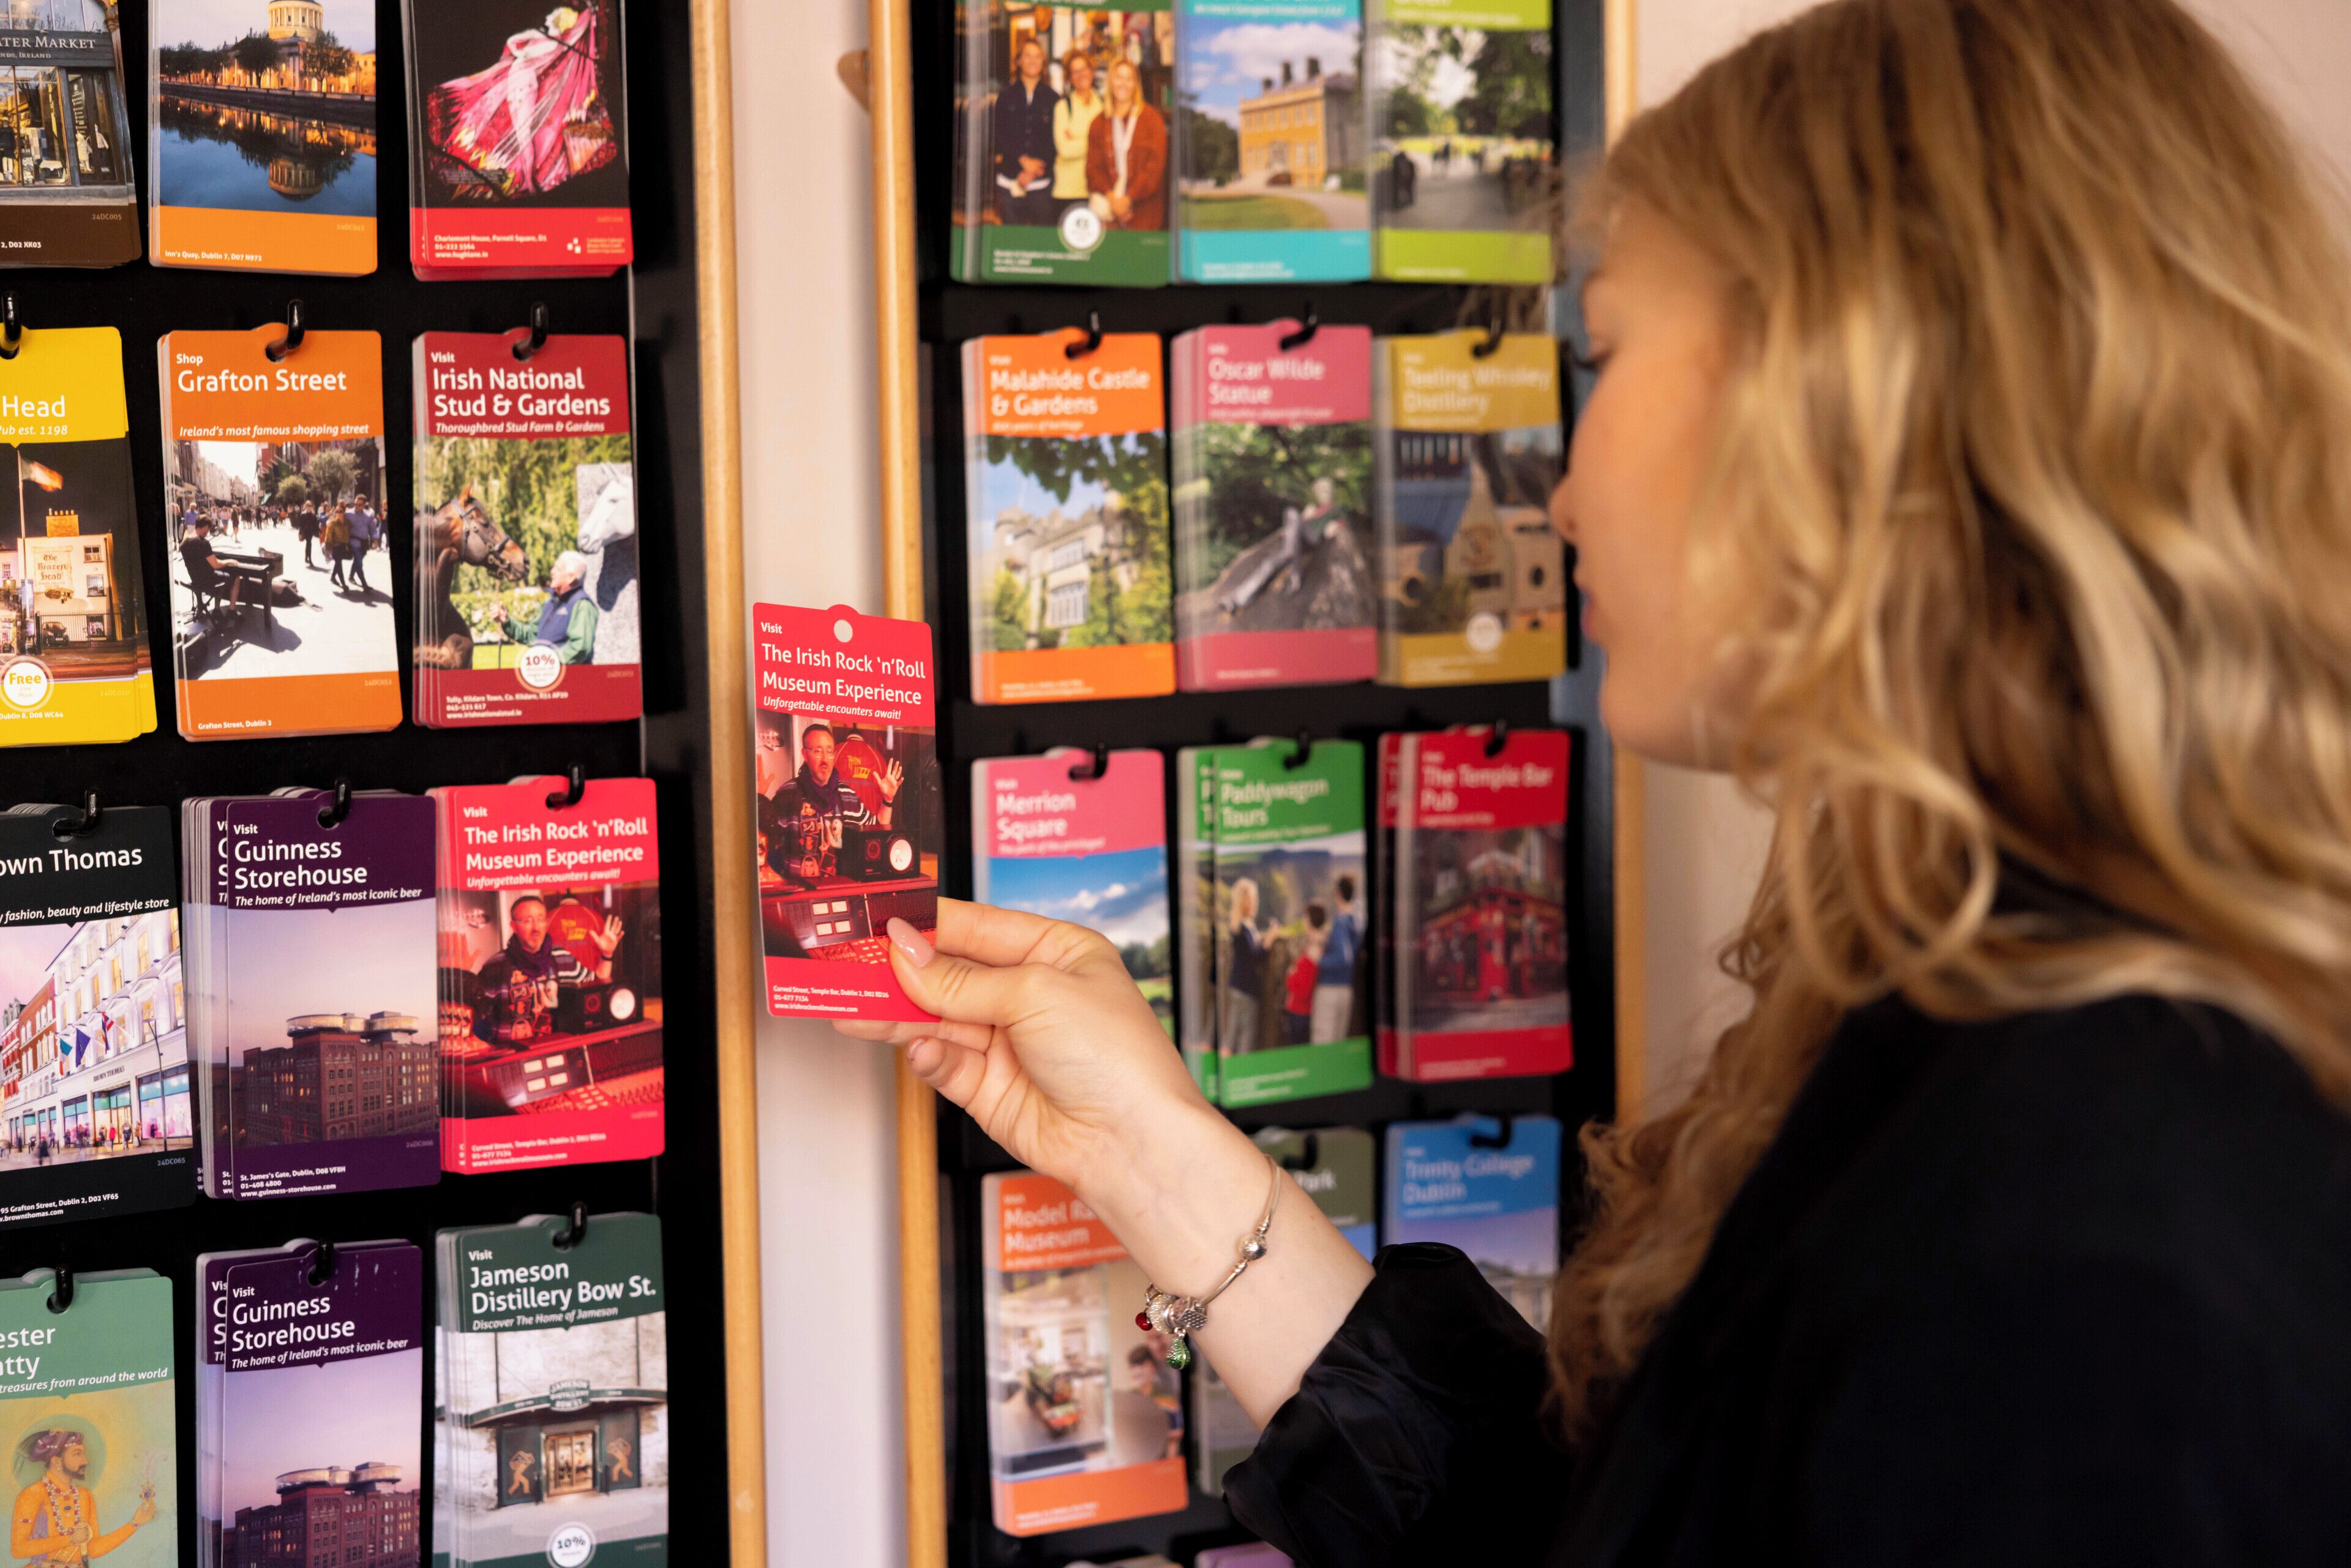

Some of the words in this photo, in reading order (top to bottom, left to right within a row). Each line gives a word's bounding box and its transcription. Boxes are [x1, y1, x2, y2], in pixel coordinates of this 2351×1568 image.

[35, 36, 96, 49] MARKET
[201, 251, 222, 260] Dublin
[176, 354, 203, 366] Shop
[431, 351, 455, 363] Visit
[178, 369, 268, 392] Grafton
[276, 369, 347, 391] Street
[433, 367, 482, 390] Irish
[490, 366, 585, 390] National
[991, 368, 1084, 391] Malahide
[1087, 367, 1150, 389] Castle
[1209, 358, 1264, 381] Oscar
[1266, 358, 1326, 381] Wilde
[991, 394, 1009, 416] &
[1013, 393, 1098, 416] Gardens
[1208, 381, 1273, 405] Statue
[2, 396, 65, 417] Head
[434, 393, 486, 417] Stud
[493, 393, 512, 416] &
[517, 393, 610, 416] Gardens
[18, 426, 36, 435] est.
[40, 426, 68, 435] 1198
[179, 426, 223, 437] Ireland's
[226, 427, 251, 436] most
[252, 425, 290, 438] famous
[292, 424, 339, 437] shopping
[340, 424, 369, 434] street
[436, 422, 504, 435] Thoroughbred
[506, 421, 528, 433] Stud
[529, 421, 554, 432] Farm
[565, 421, 605, 432] Gardens
[760, 622, 782, 634] Visit
[525, 655, 555, 666] 10%
[762, 643, 792, 663] The
[797, 647, 831, 668] Irish
[836, 651, 874, 672] Rock
[763, 671, 831, 695] Museum
[836, 679, 921, 705] Experience
[763, 696, 824, 712] Unforgettable
[825, 705, 873, 718] encounters
[874, 710, 901, 719] await!
[996, 790, 1076, 816] Merrion
[1220, 779, 1330, 807] Paddywagon
[463, 807, 488, 817] Visit
[1223, 806, 1268, 828] Tours
[233, 823, 258, 835] Visit
[465, 827, 498, 844] The
[503, 823, 541, 842] Irish
[547, 821, 588, 840] Rock
[997, 817, 1068, 843] Square
[49, 849, 143, 871] Thomas
[234, 839, 342, 863] Guinness
[467, 852, 542, 871] Museum
[546, 846, 644, 869] Experience
[234, 865, 367, 890] Storehouse
[467, 874, 534, 890] Unforgettable
[536, 871, 588, 883] encounters
[590, 868, 621, 880] await!
[235, 896, 253, 906] The
[255, 894, 283, 906] home
[286, 893, 296, 906] of
[298, 891, 340, 903] Ireland's
[342, 890, 367, 901] most
[369, 888, 398, 899] iconic
[400, 887, 422, 898] beer
[5, 909, 45, 923] fashion,
[48, 906, 81, 918] beauty
[83, 902, 102, 914] and
[105, 899, 143, 913] lifestyle
[144, 899, 169, 909] store
[157, 1157, 186, 1166] 24DC065
[250, 1172, 274, 1180] James's
[275, 1171, 291, 1179] Gate,
[292, 1168, 315, 1177] Dublin,
[241, 1184, 336, 1198] www.guinness-storehouse.com
[10, 1203, 35, 1213] Grafton
[36, 1201, 58, 1210] Street,
[59, 1199, 80, 1207] Dublin
[1003, 1227, 1090, 1253] Museum
[468, 1250, 493, 1261] Visit
[470, 1262, 569, 1289] Jameson
[233, 1286, 255, 1299] Visit
[472, 1286, 572, 1315] Distillery
[577, 1281, 624, 1303] Bow
[628, 1275, 656, 1298] St.
[233, 1296, 331, 1325] Guinness
[472, 1317, 514, 1331] Discover
[516, 1315, 534, 1326] The
[535, 1313, 563, 1324] Home
[565, 1309, 576, 1323] of
[577, 1307, 618, 1319] Jameson
[231, 1321, 356, 1352] Storehouse
[232, 1359, 248, 1369] The
[250, 1356, 276, 1367] home
[277, 1353, 288, 1365] of
[289, 1347, 329, 1361] Ireland's
[331, 1346, 354, 1356] most
[356, 1341, 385, 1353] iconic
[387, 1339, 409, 1348] beer
[49, 1379, 75, 1391] from
[78, 1373, 116, 1386] around
[119, 1371, 135, 1381] the
[138, 1368, 168, 1379] world
[557, 1536, 586, 1549] 10%
